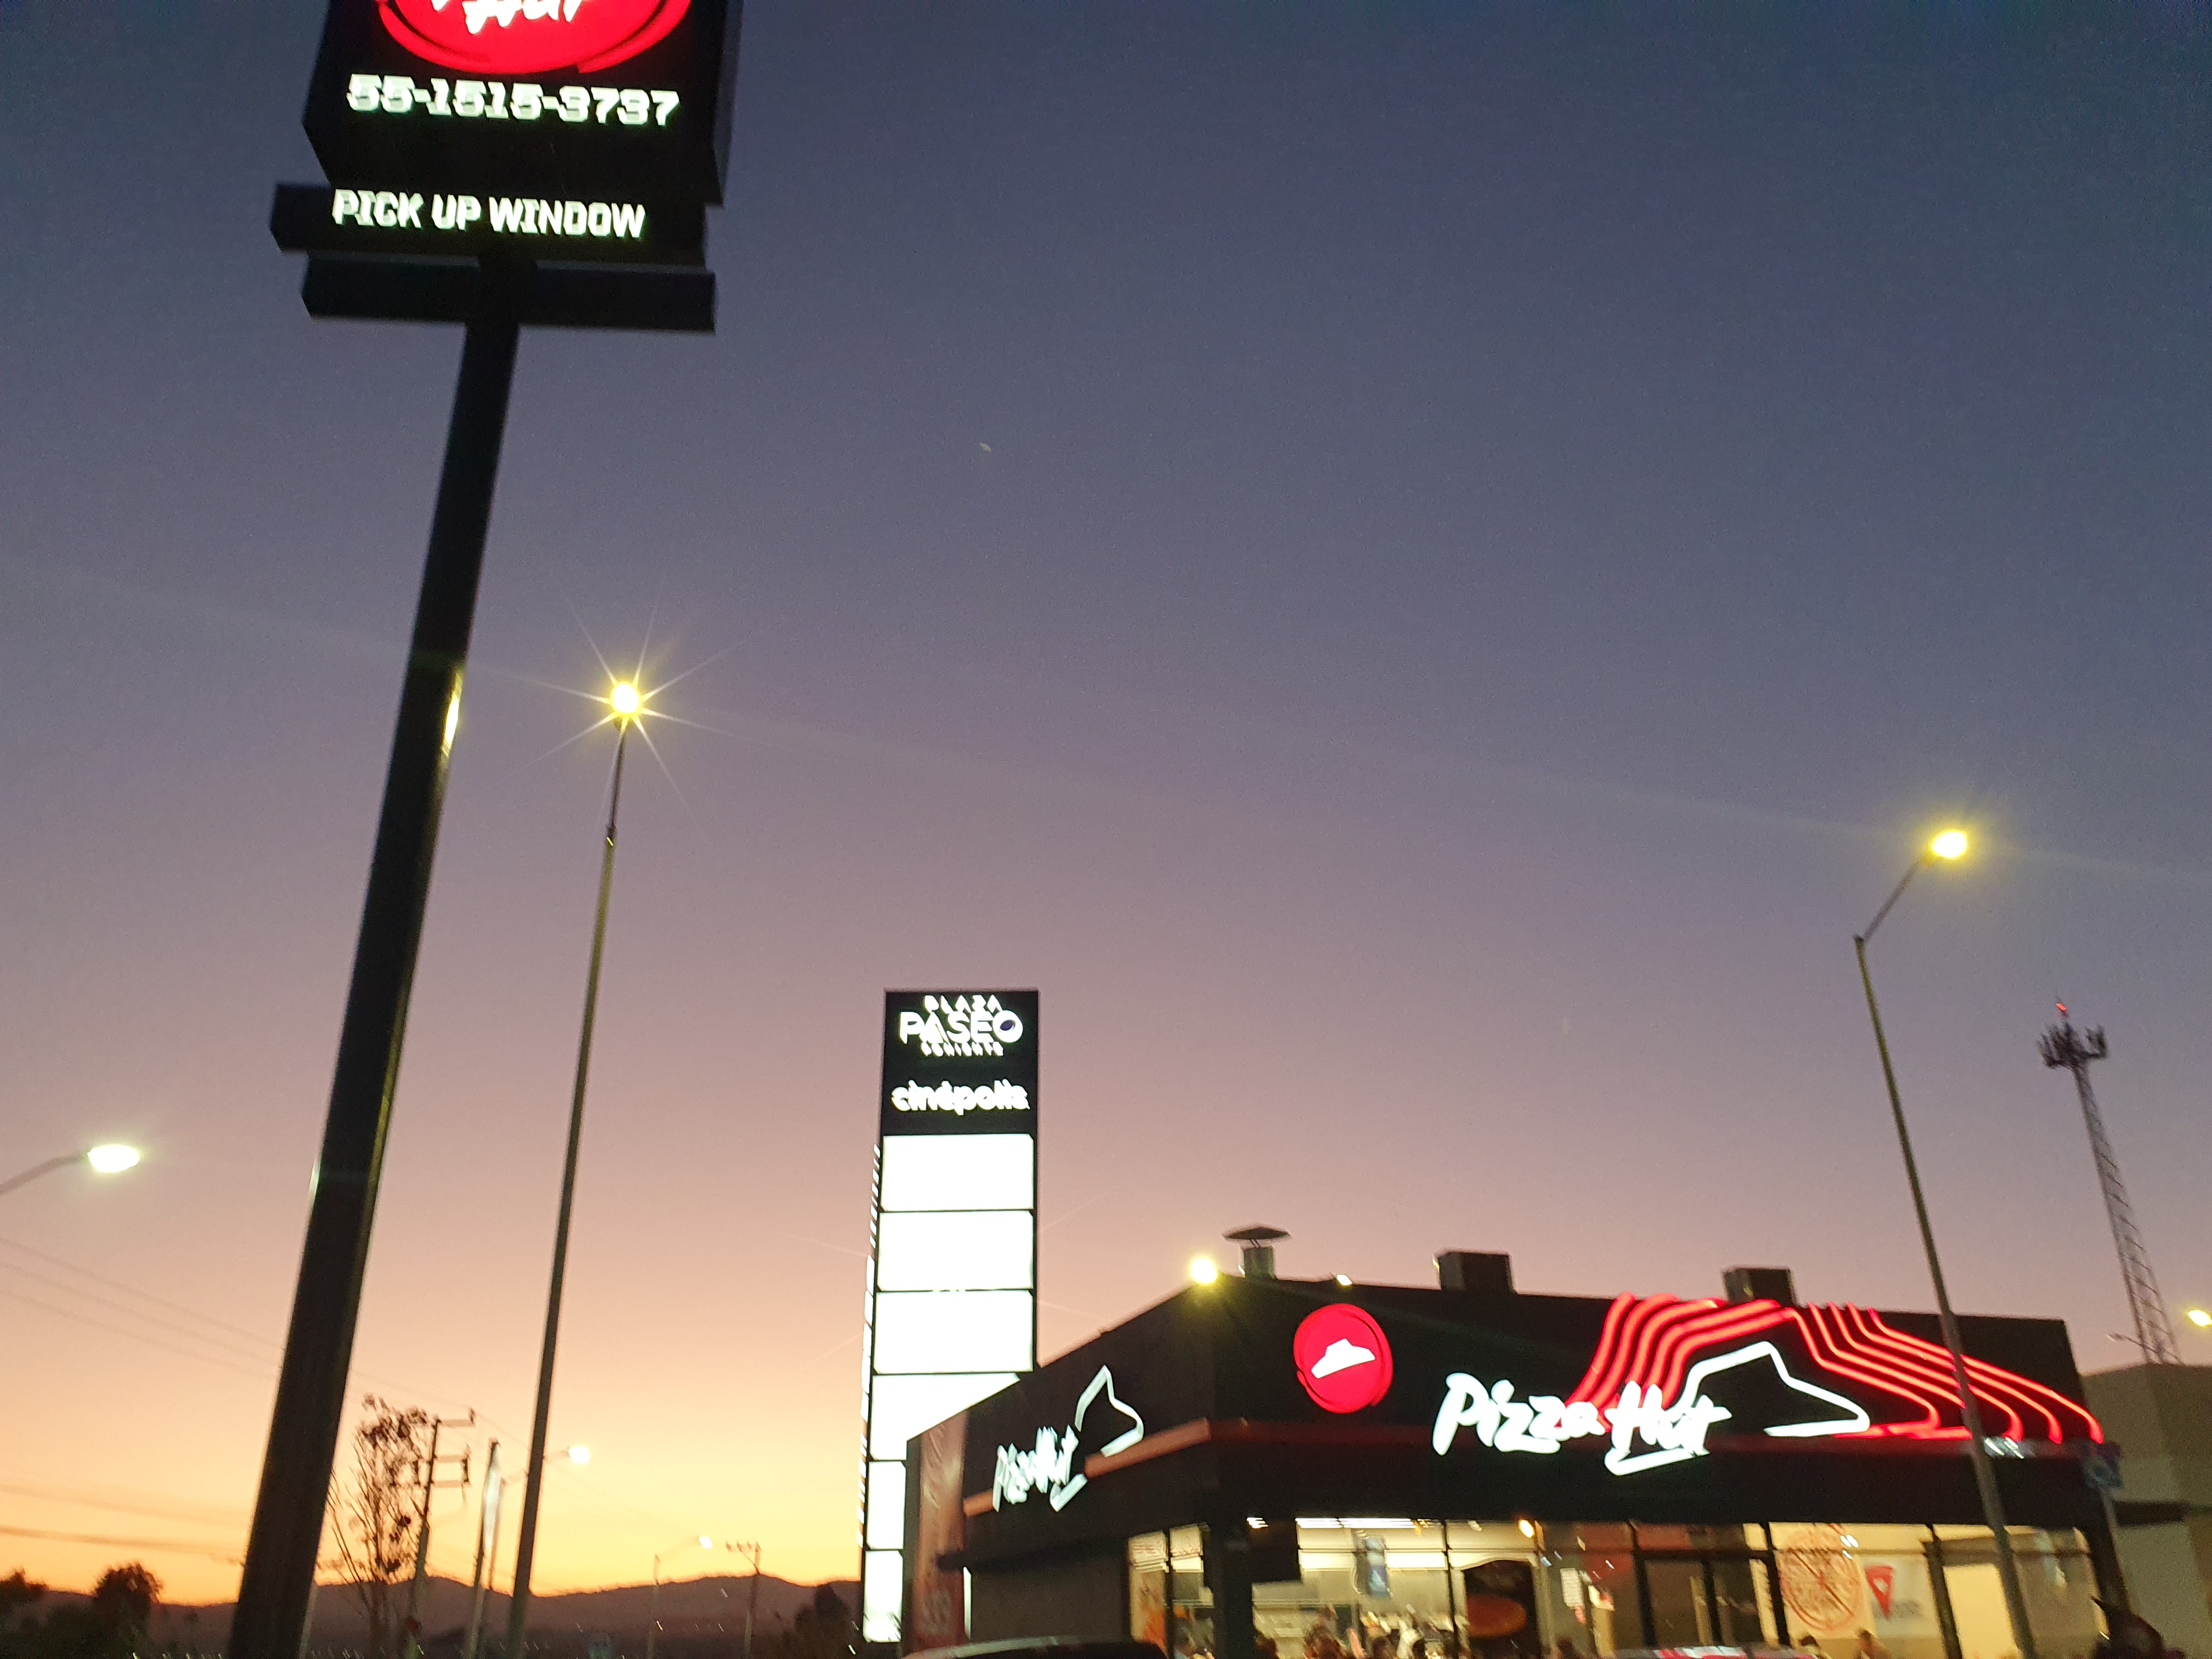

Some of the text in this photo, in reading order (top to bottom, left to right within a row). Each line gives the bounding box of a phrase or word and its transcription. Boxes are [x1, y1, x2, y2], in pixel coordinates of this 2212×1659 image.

[346, 74, 679, 126] 55-1515-3737
[332, 189, 646, 238] PICK UP WINDOW
[899, 1010, 1023, 1045] PASEO
[923, 994, 1003, 1013] PLAZA
[1432, 1373, 1733, 1476] Pizza Hut
